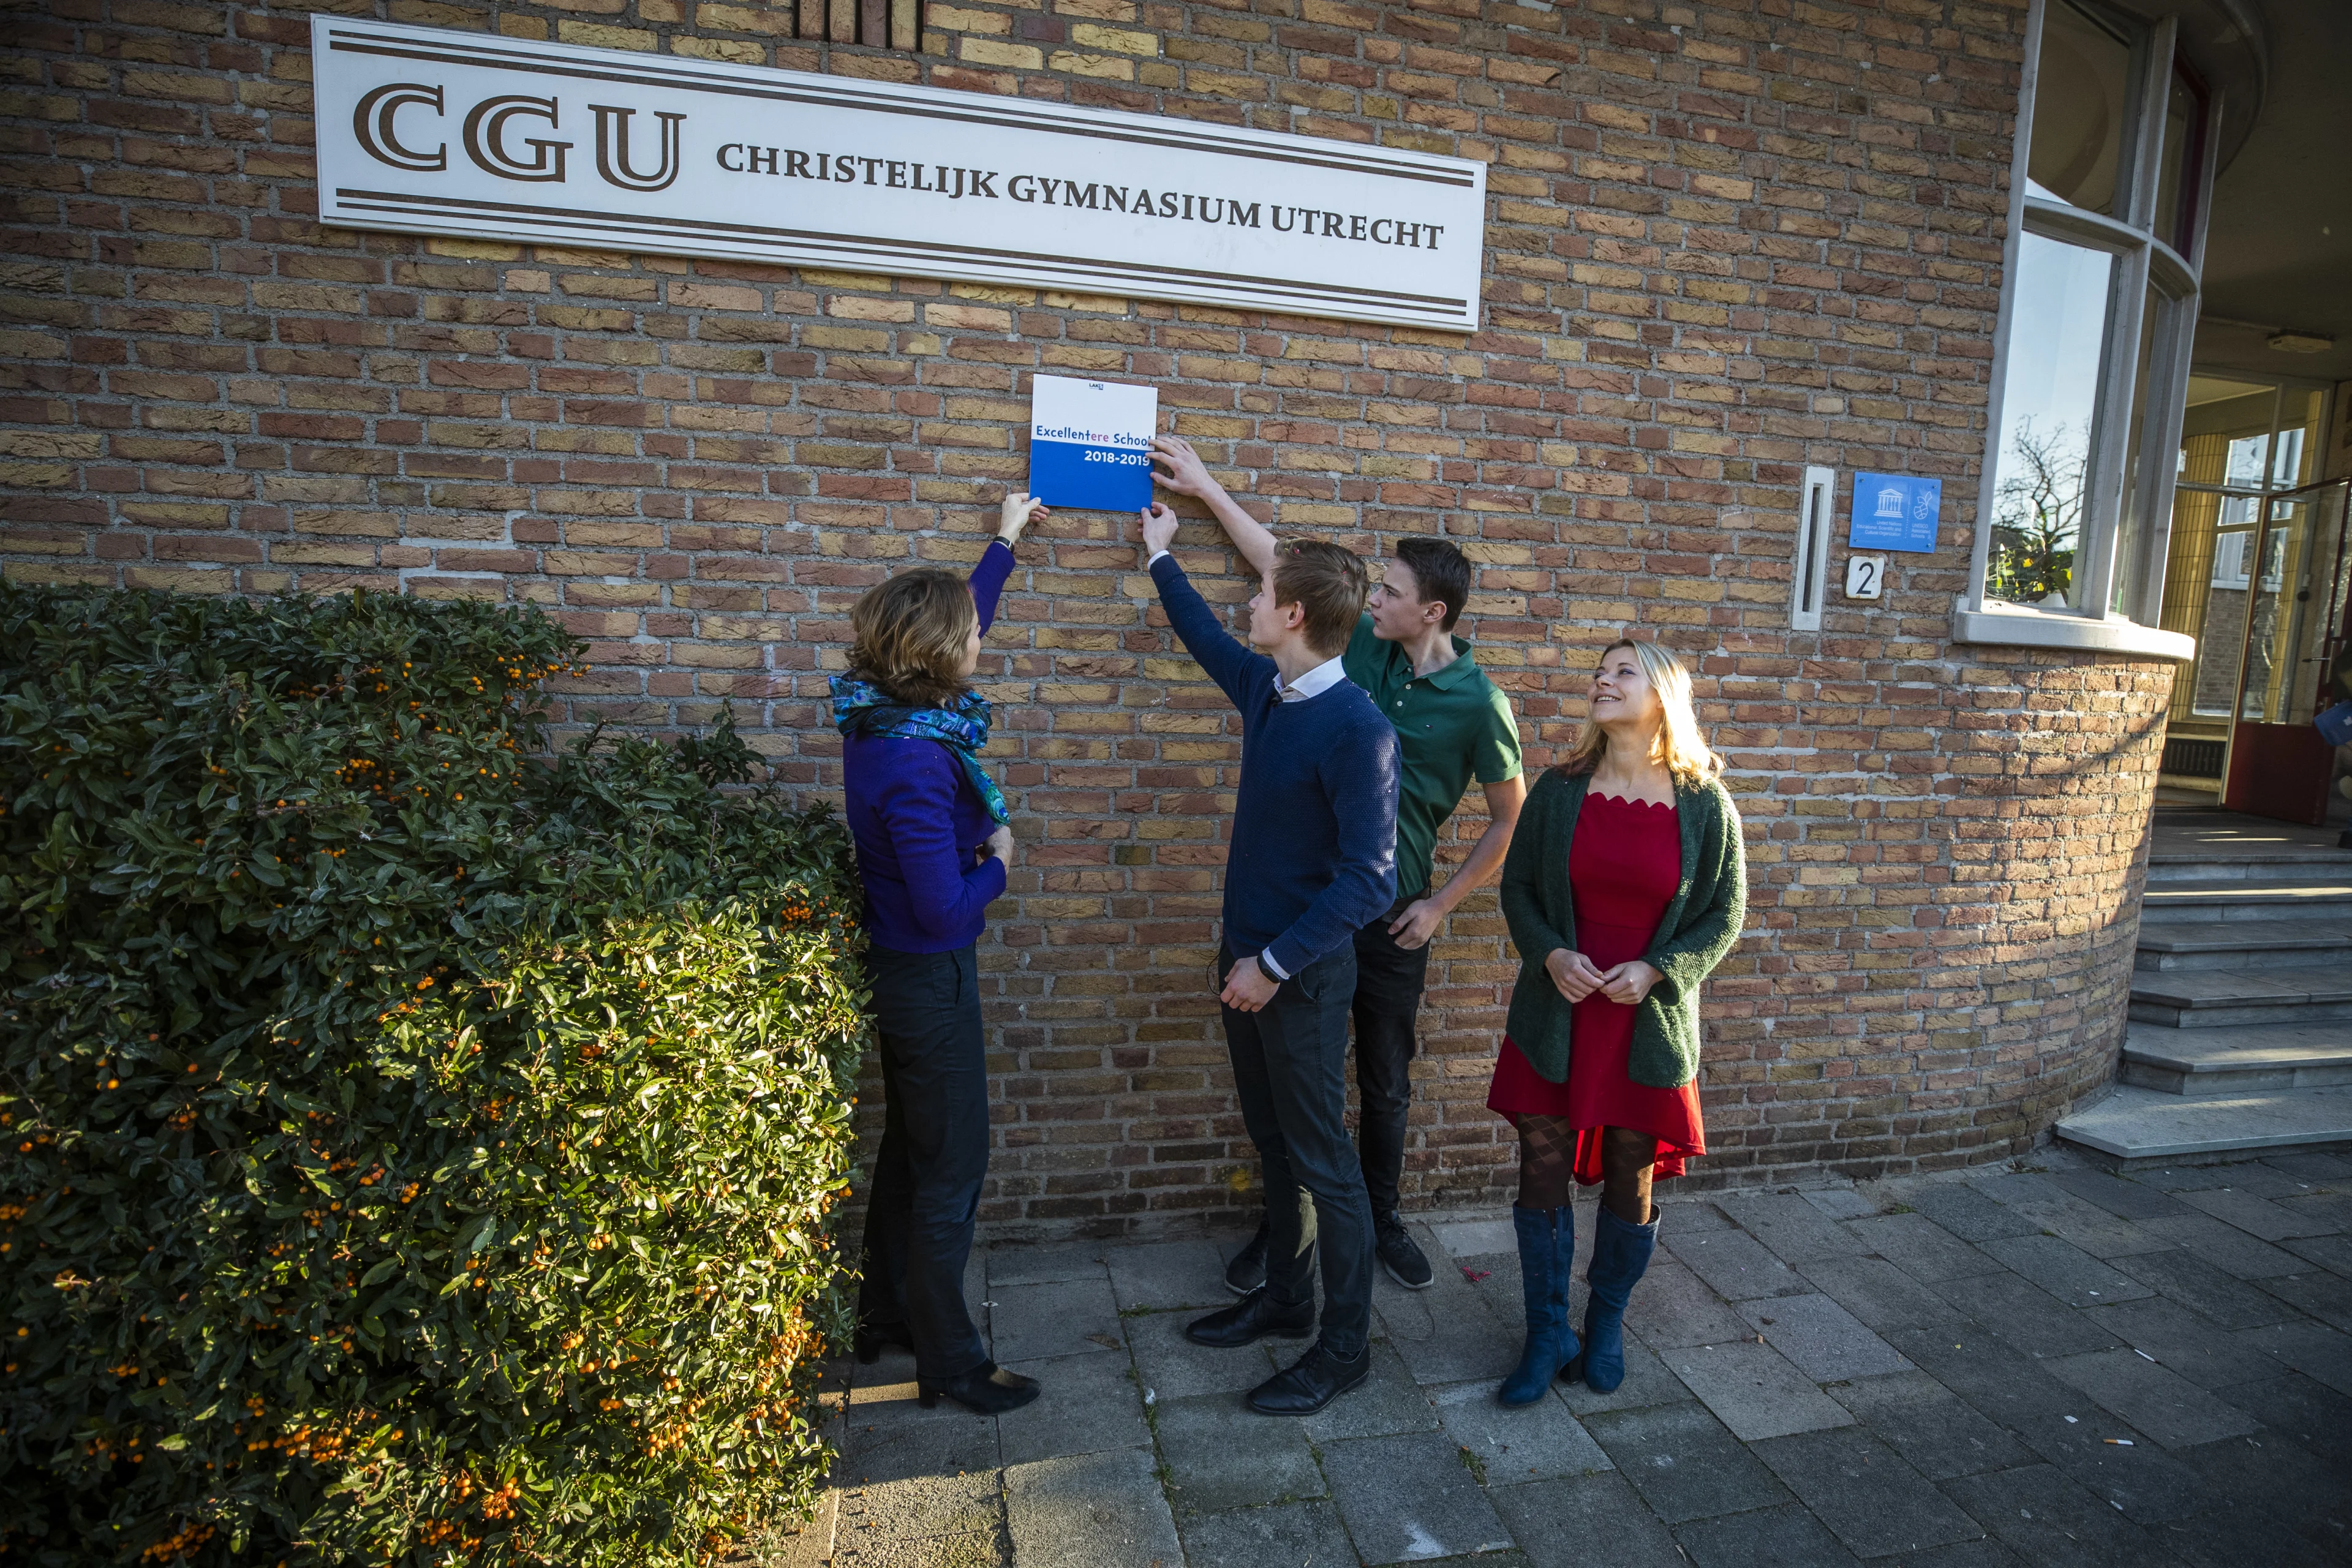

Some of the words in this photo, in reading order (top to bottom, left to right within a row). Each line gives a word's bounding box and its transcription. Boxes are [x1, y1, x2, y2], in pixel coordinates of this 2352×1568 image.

[353, 83, 687, 192] CGU
[716, 143, 999, 199] CHRISTELIJK
[1008, 175, 1261, 228] GYMNASIUM
[1270, 205, 1444, 250] UTRECHT
[1036, 425, 1109, 442] Excellentere
[1084, 450, 1150, 466] 2018-2019
[1856, 562, 1874, 595] 2
